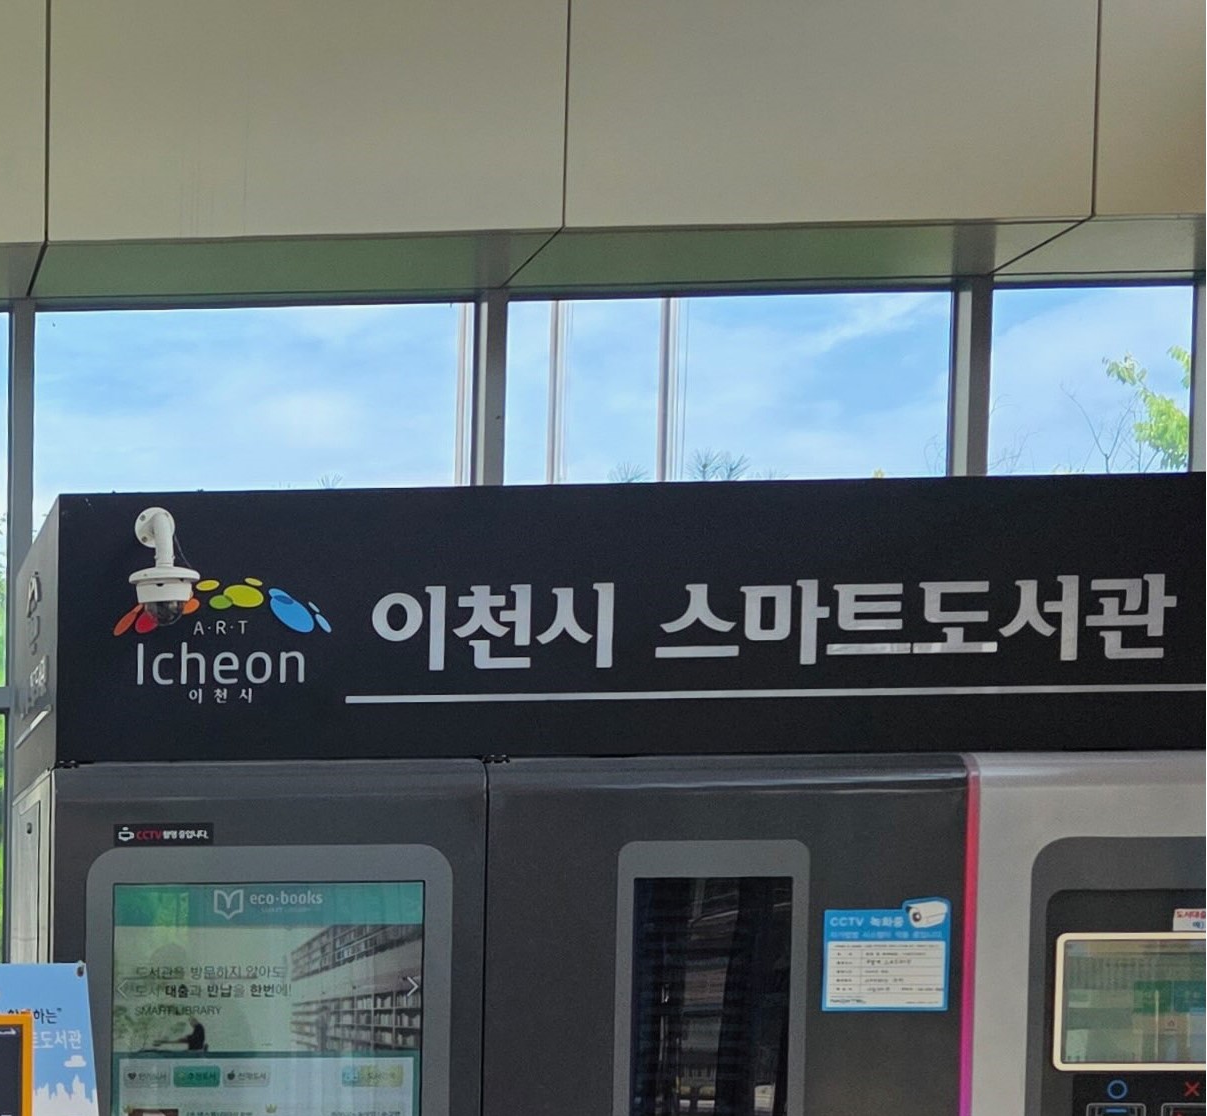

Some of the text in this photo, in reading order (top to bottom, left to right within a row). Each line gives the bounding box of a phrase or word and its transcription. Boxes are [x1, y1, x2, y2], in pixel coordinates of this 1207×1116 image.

[371, 573, 1177, 671] 이천시 스마트도서관
[136, 642, 306, 685] Icheon
[829, 915, 864, 928] CCTV
